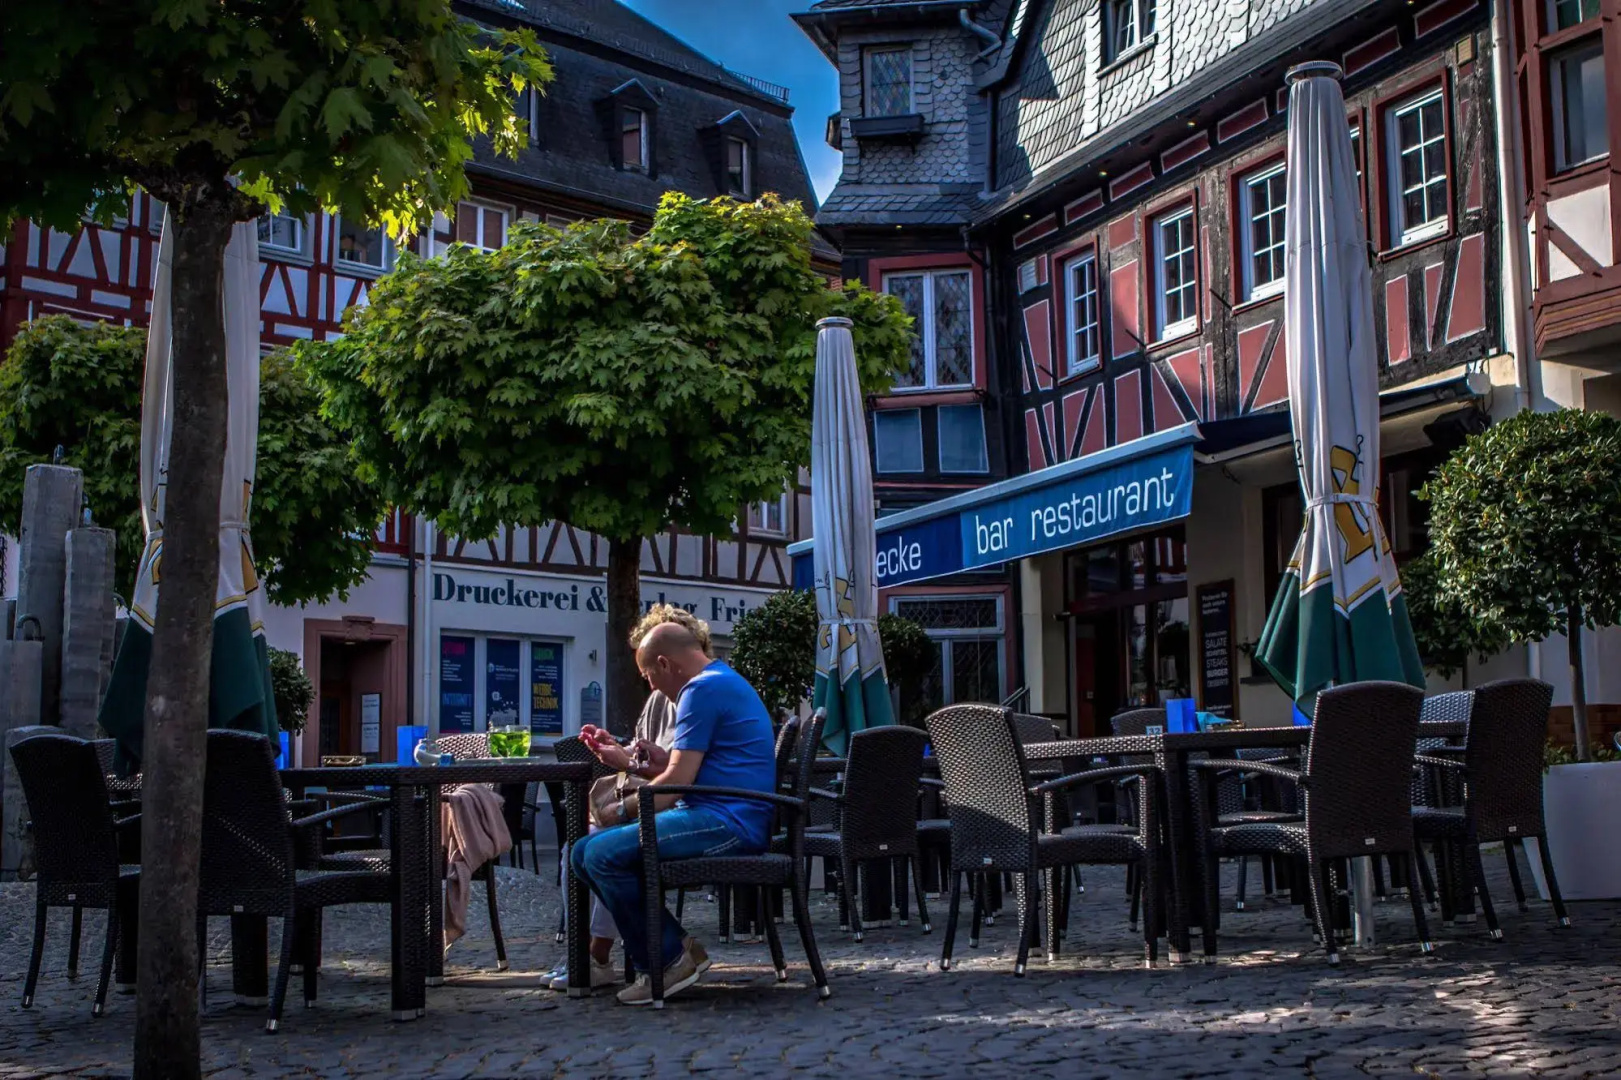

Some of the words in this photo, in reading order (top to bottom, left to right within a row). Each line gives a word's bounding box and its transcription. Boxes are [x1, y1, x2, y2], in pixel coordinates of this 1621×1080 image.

[975, 515, 1014, 554] bar
[1031, 467, 1174, 541] restaurant
[432, 573, 580, 610] Druckerei
[586, 586, 608, 612] &
[1205, 637, 1228, 649] SALATE
[1206, 657, 1228, 669] STEAKS
